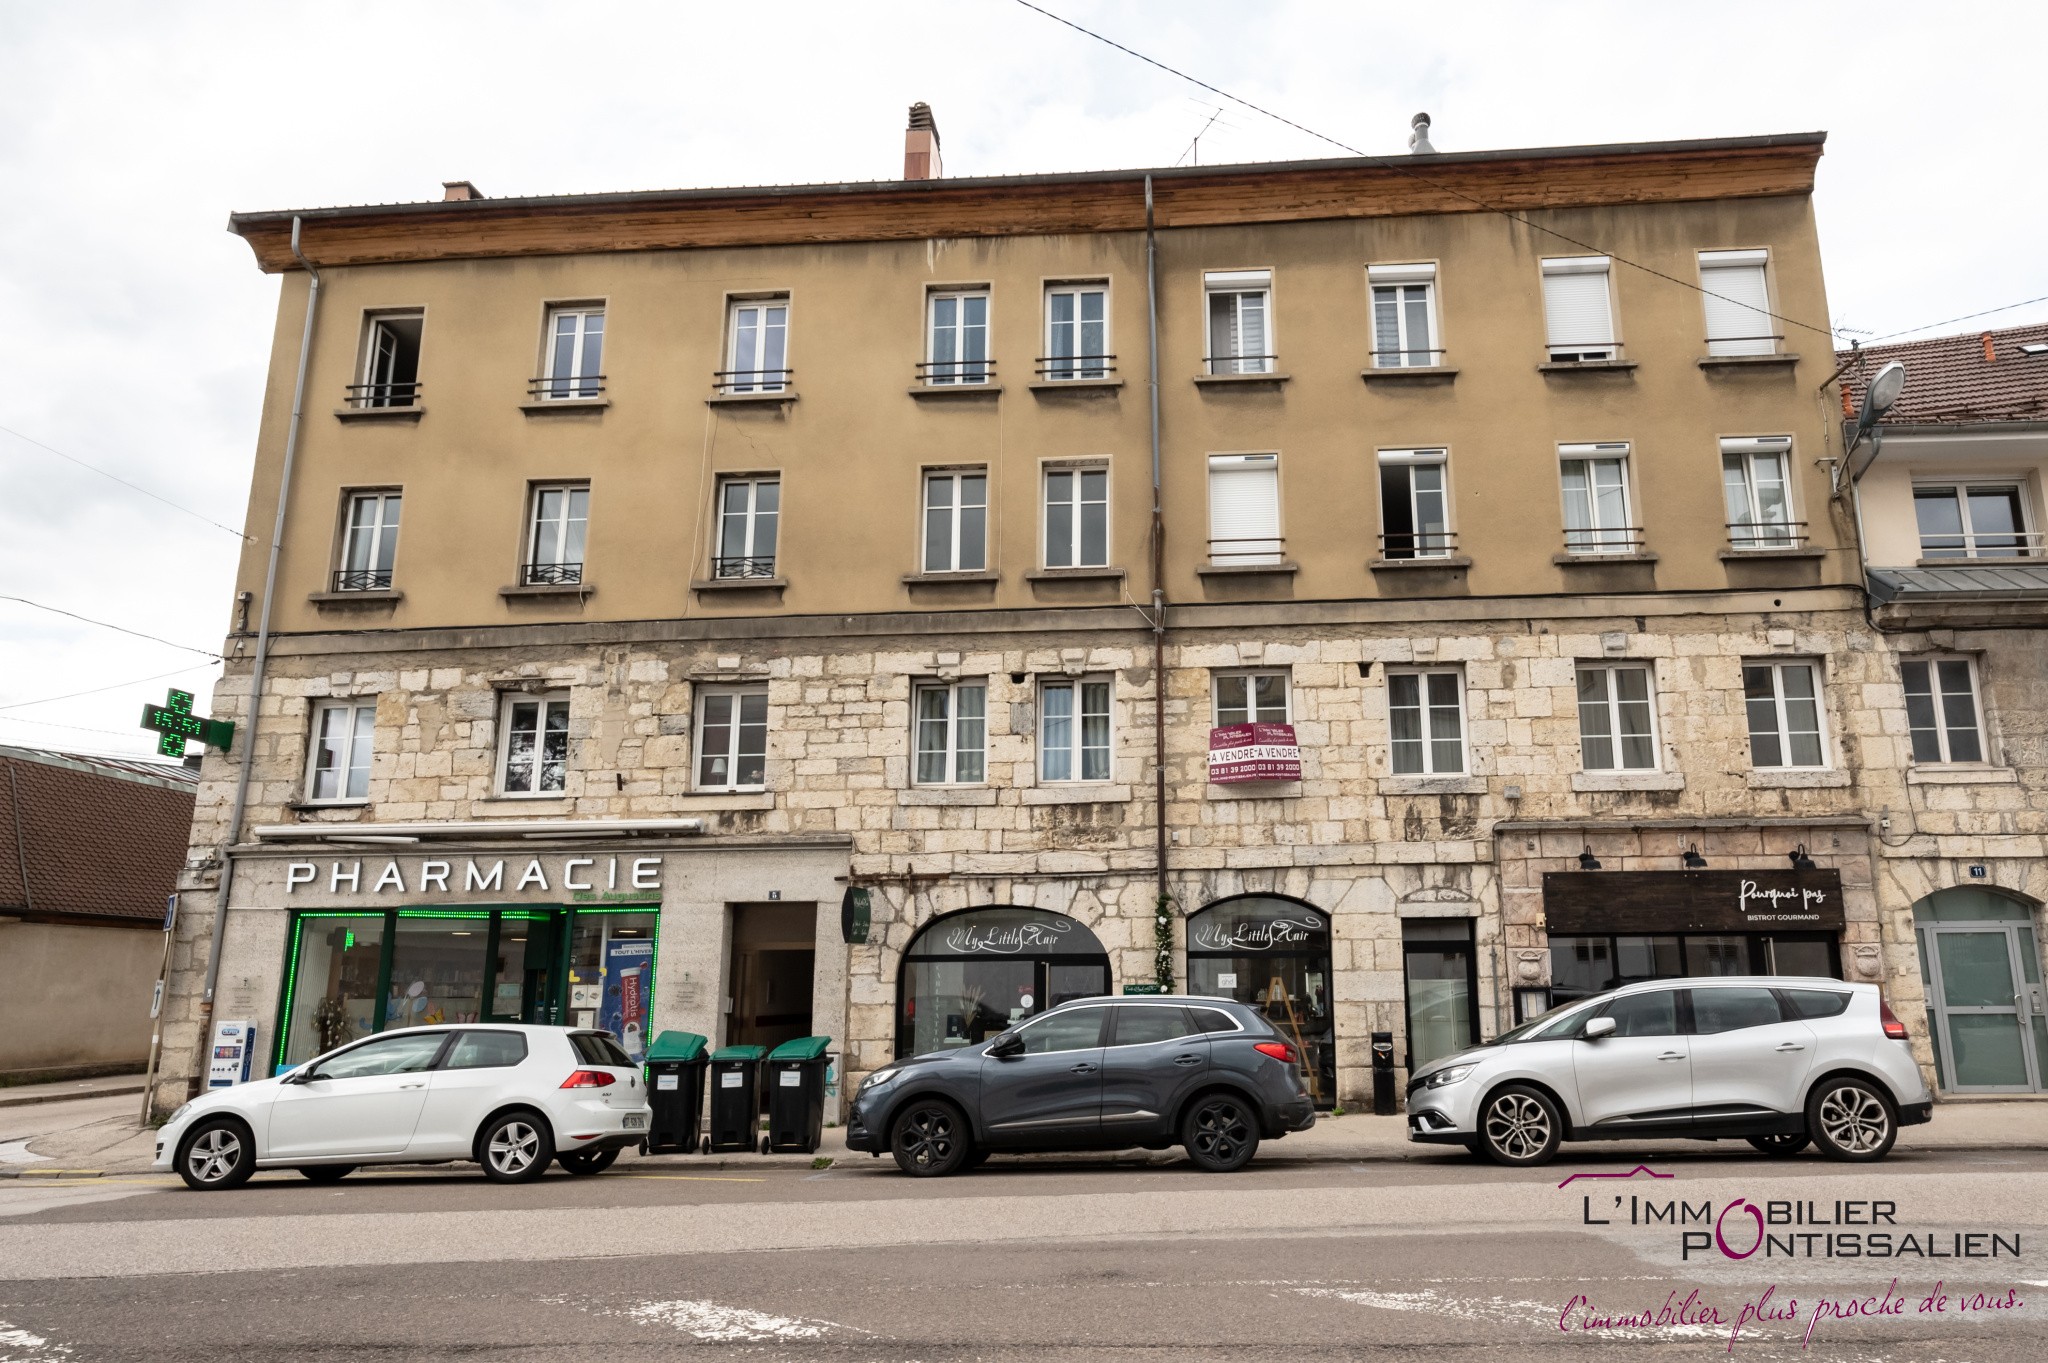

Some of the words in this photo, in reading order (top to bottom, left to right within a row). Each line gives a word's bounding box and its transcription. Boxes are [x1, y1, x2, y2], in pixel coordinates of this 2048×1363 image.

[1220, 748, 1254, 761] VENDRE
[1265, 748, 1298, 758] VENDRE
[1240, 764, 1256, 772] 2000
[285, 857, 663, 894] PHARMACIE
[1973, 867, 1983, 876] 11
[1738, 879, 1799, 911] Pourquoi
[947, 926, 981, 952] My
[981, 926, 1021, 951] Little
[1022, 922, 1063, 946] Hair
[1196, 923, 1231, 949] My
[1230, 922, 1271, 949] Little
[1272, 919, 1313, 942] Hair
